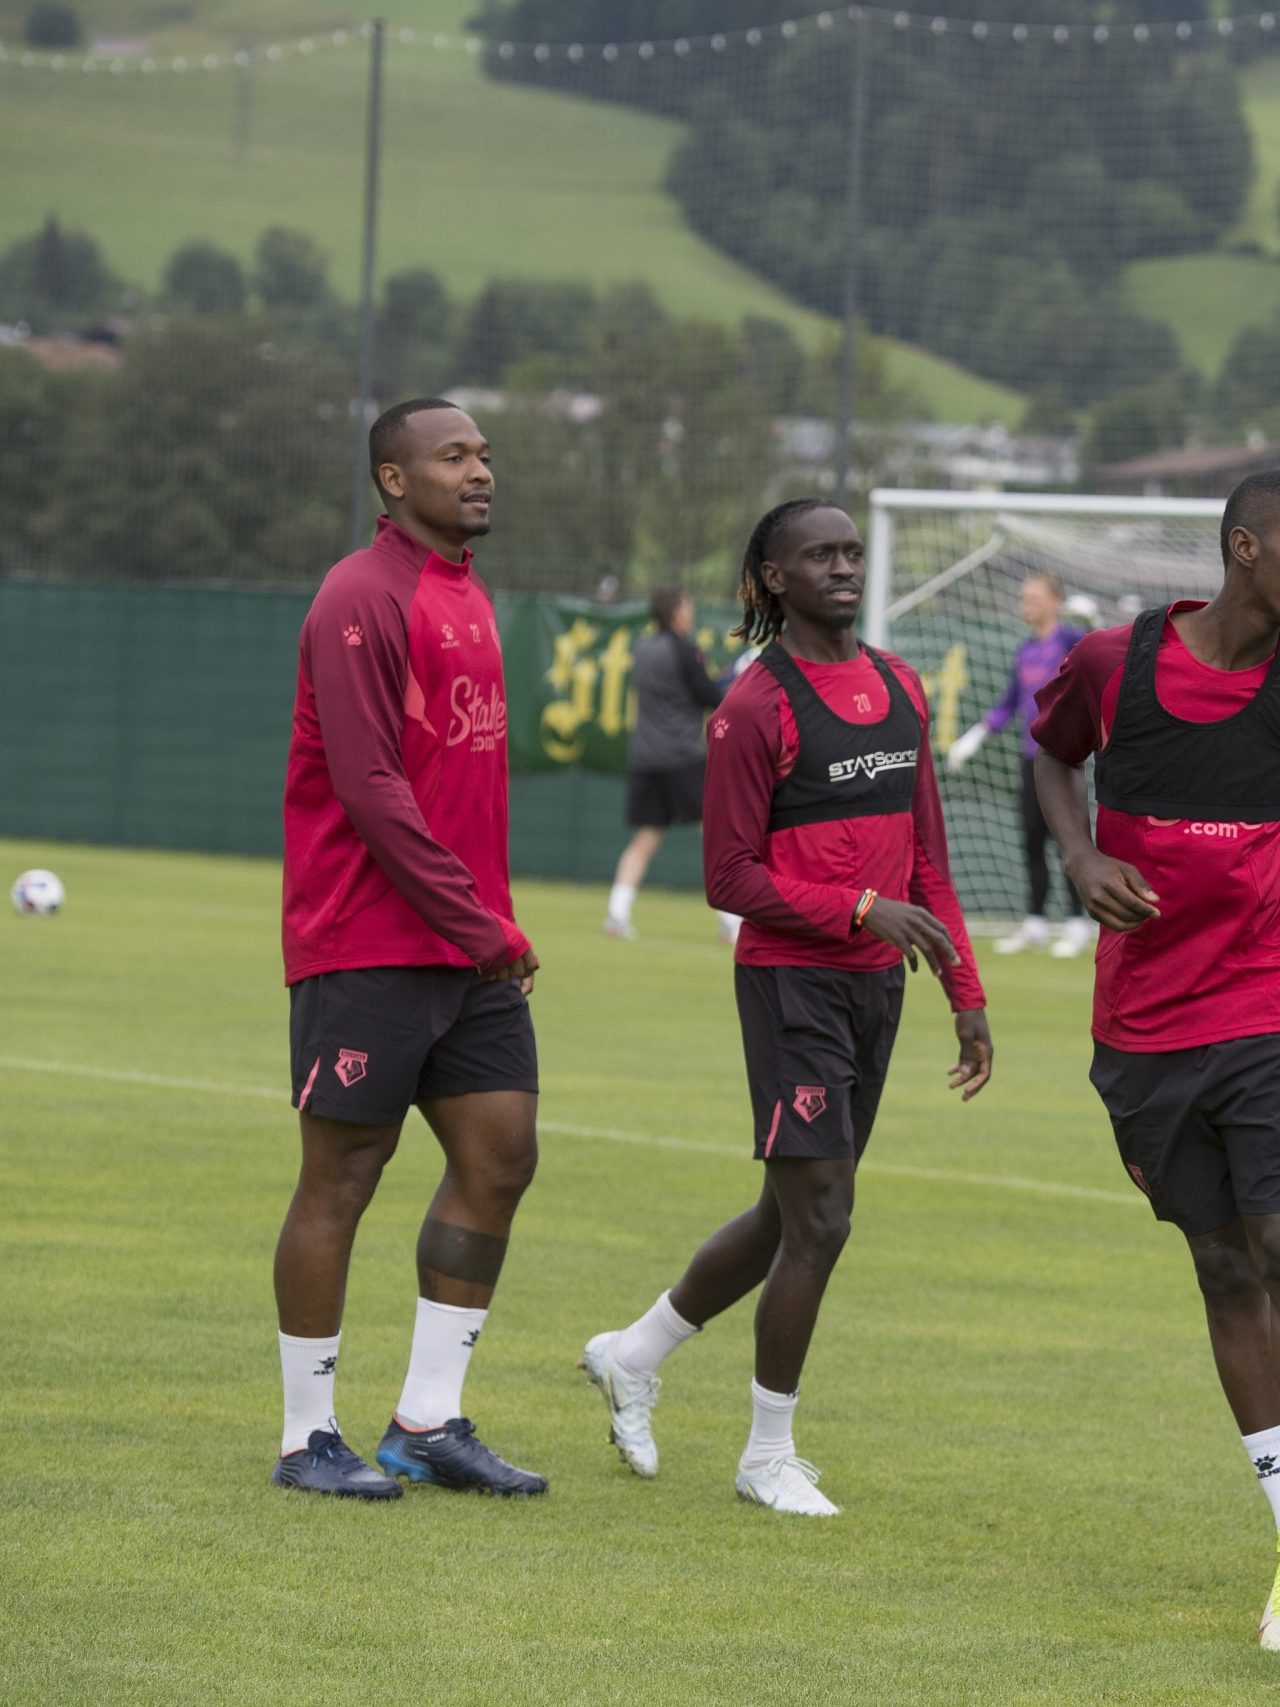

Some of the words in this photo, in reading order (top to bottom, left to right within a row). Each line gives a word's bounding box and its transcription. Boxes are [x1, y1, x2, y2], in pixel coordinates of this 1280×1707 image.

[447, 675, 506, 746] Stake
[853, 693, 872, 713] 20
[1184, 822, 1238, 838] .com
